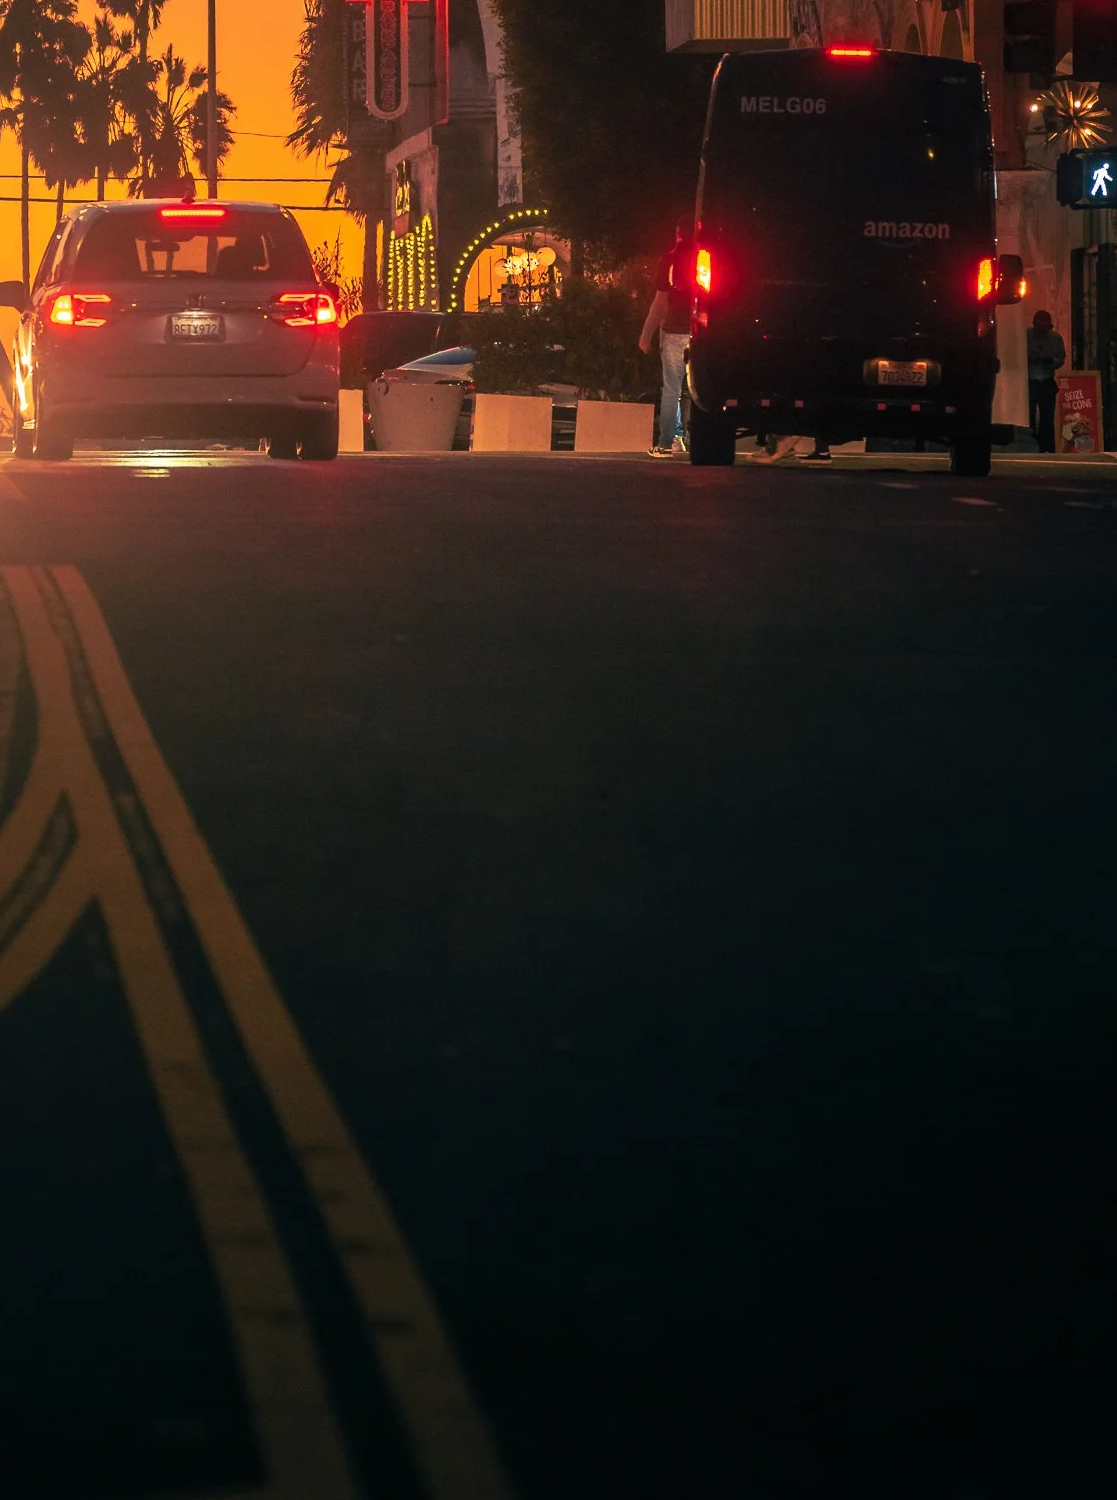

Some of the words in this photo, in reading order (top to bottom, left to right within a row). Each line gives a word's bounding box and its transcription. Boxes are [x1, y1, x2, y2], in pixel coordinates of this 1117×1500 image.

[740, 97, 827, 114] MELG06
[864, 220, 951, 239] amazon
[1064, 389, 1085, 401] SEIZE
